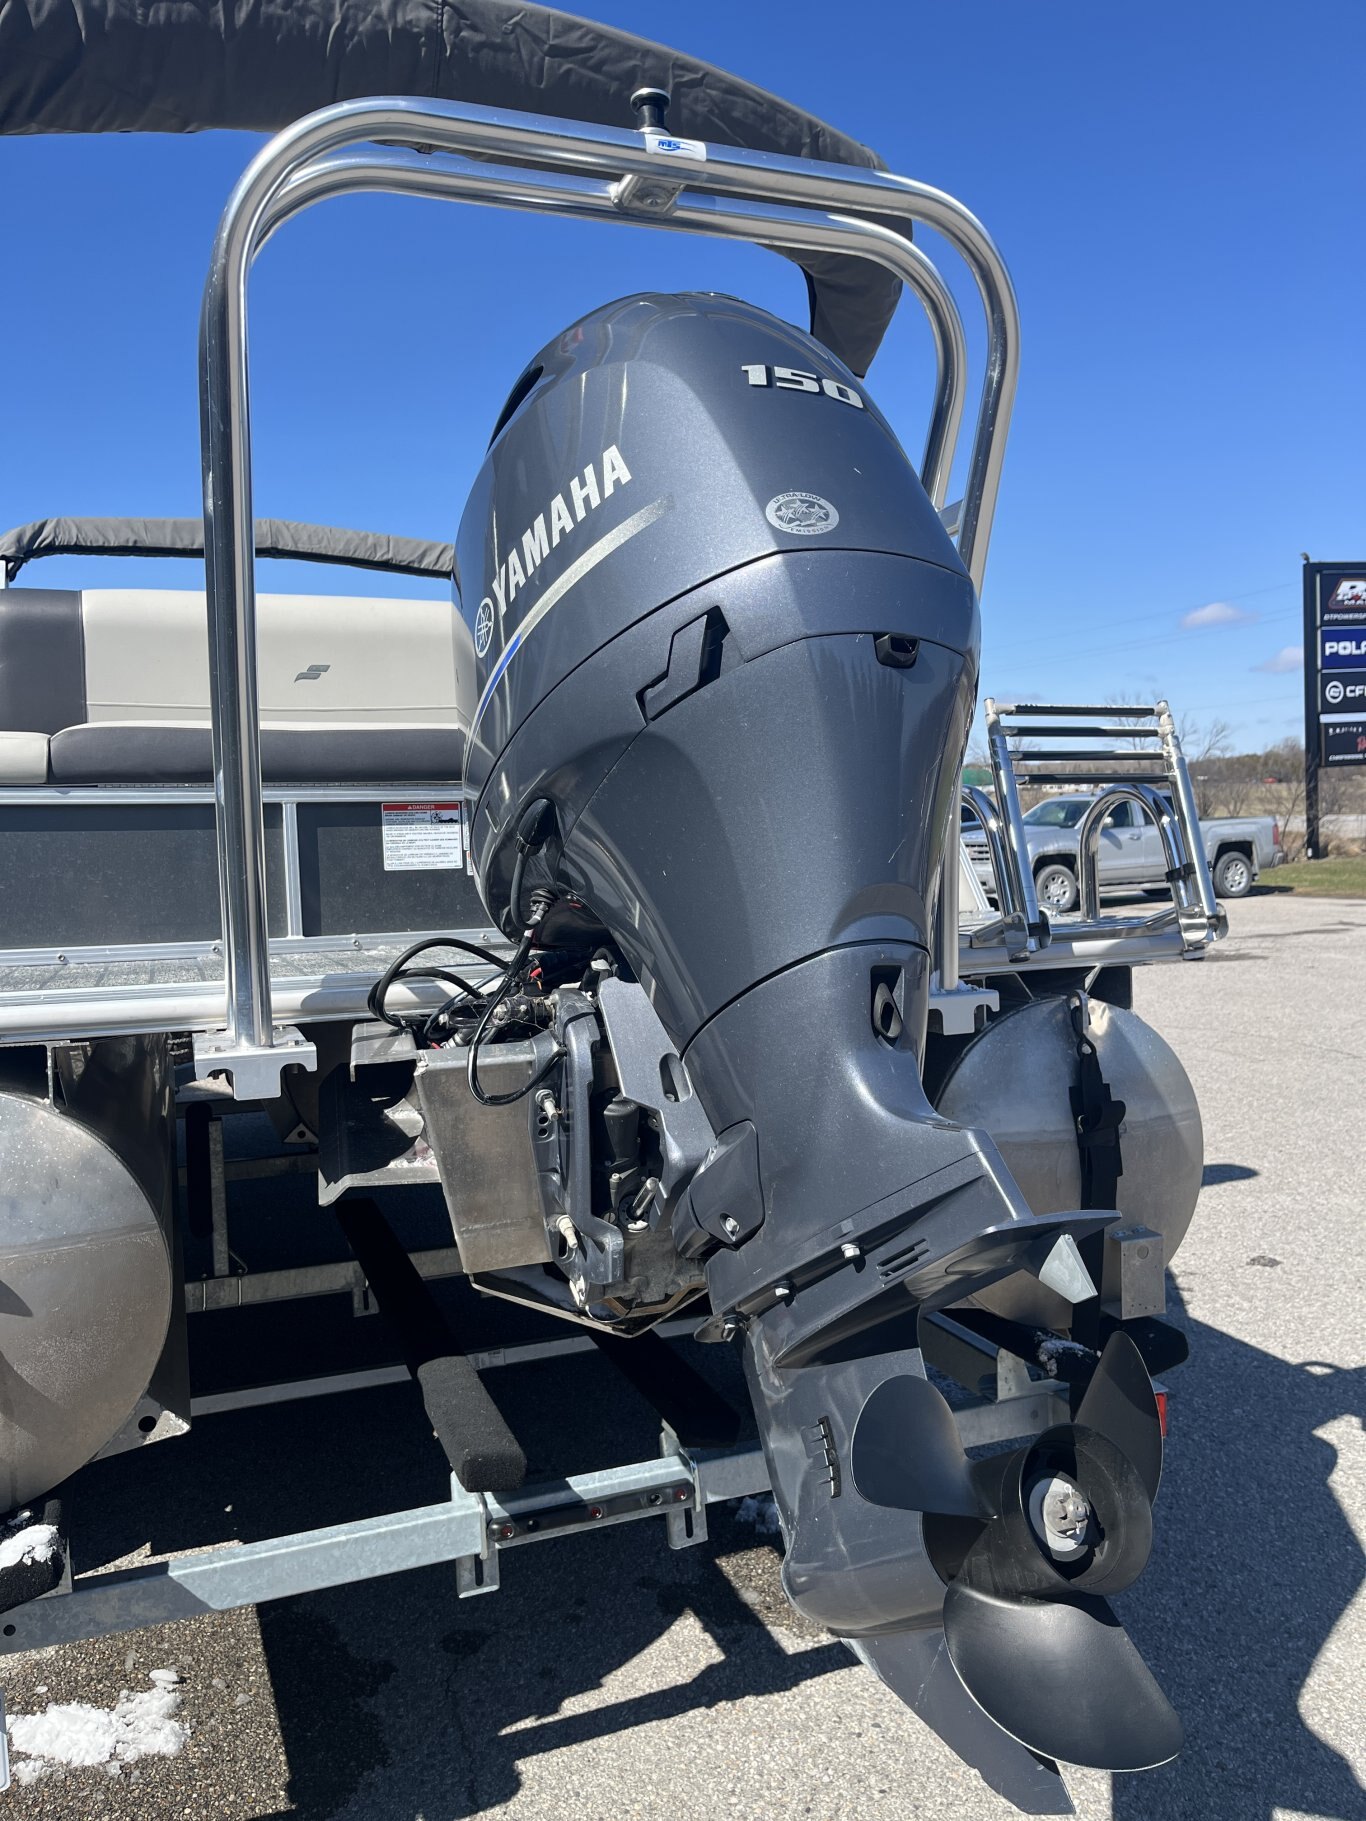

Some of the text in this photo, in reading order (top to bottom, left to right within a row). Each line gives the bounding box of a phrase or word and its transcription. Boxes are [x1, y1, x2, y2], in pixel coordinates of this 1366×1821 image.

[740, 364, 864, 409] 150
[773, 492, 822, 504] ULTRA LOW
[491, 444, 632, 617] YAMAHA
[1346, 685, 1366, 698] CF
